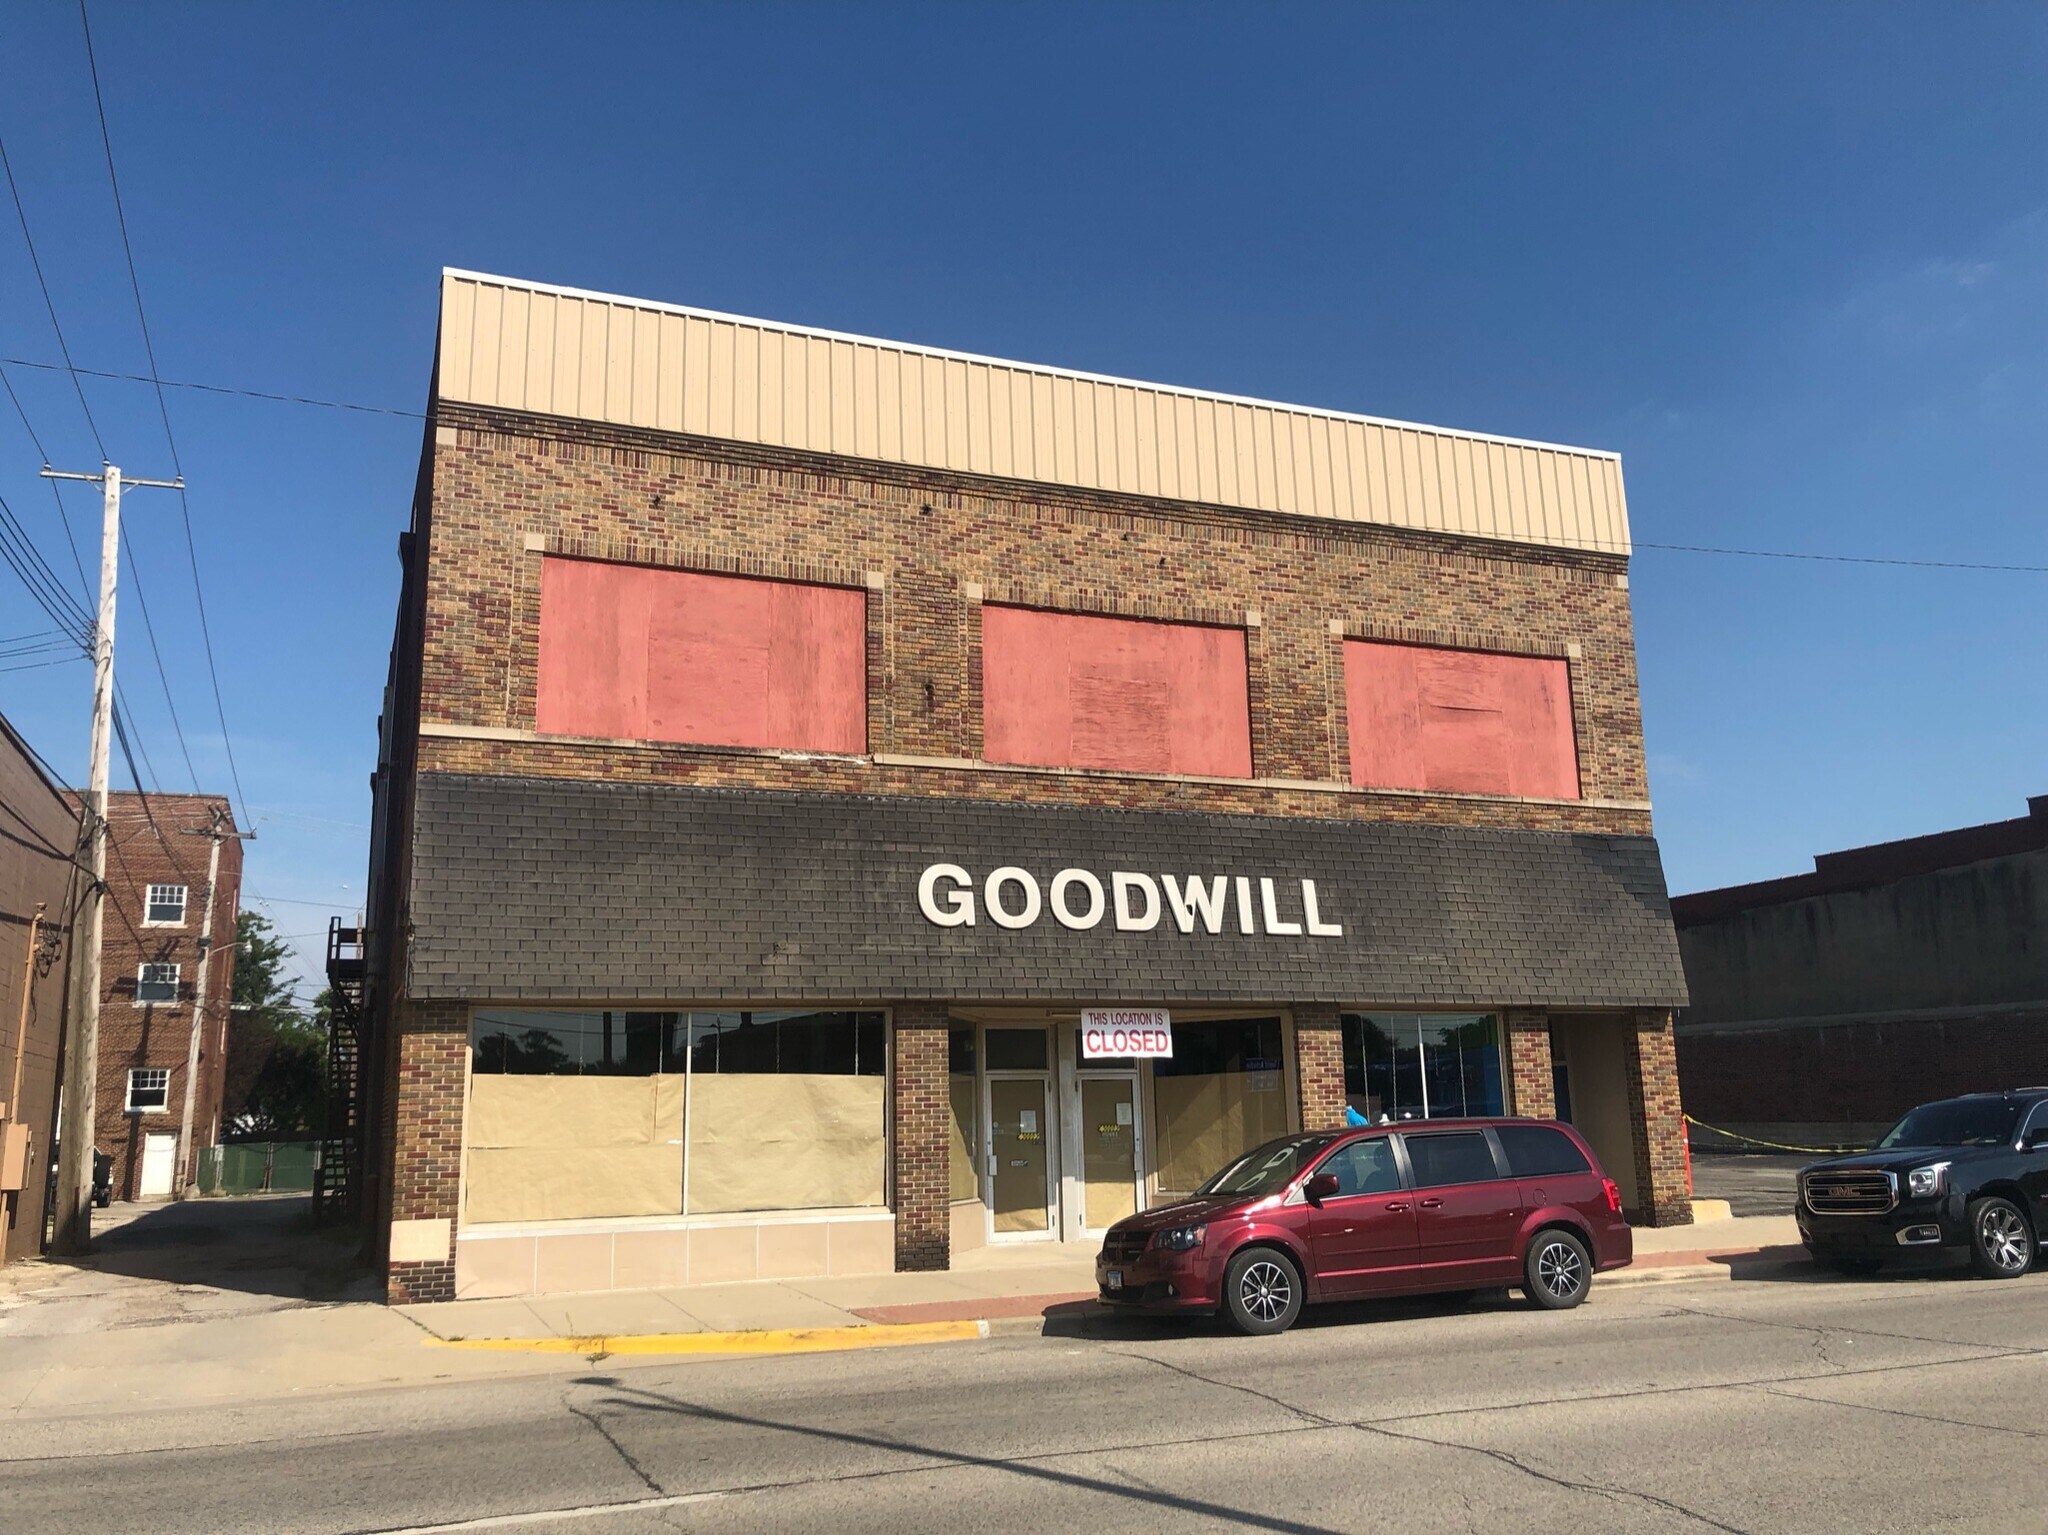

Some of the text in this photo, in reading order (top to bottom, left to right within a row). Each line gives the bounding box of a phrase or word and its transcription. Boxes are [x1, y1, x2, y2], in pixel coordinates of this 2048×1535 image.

[917, 863, 1343, 937] GOODWILL
[1088, 1012, 1164, 1026] THIS LOCATION IS
[1086, 1029, 1168, 1053] CLOSED
[1828, 1186, 1861, 1197] GMC
